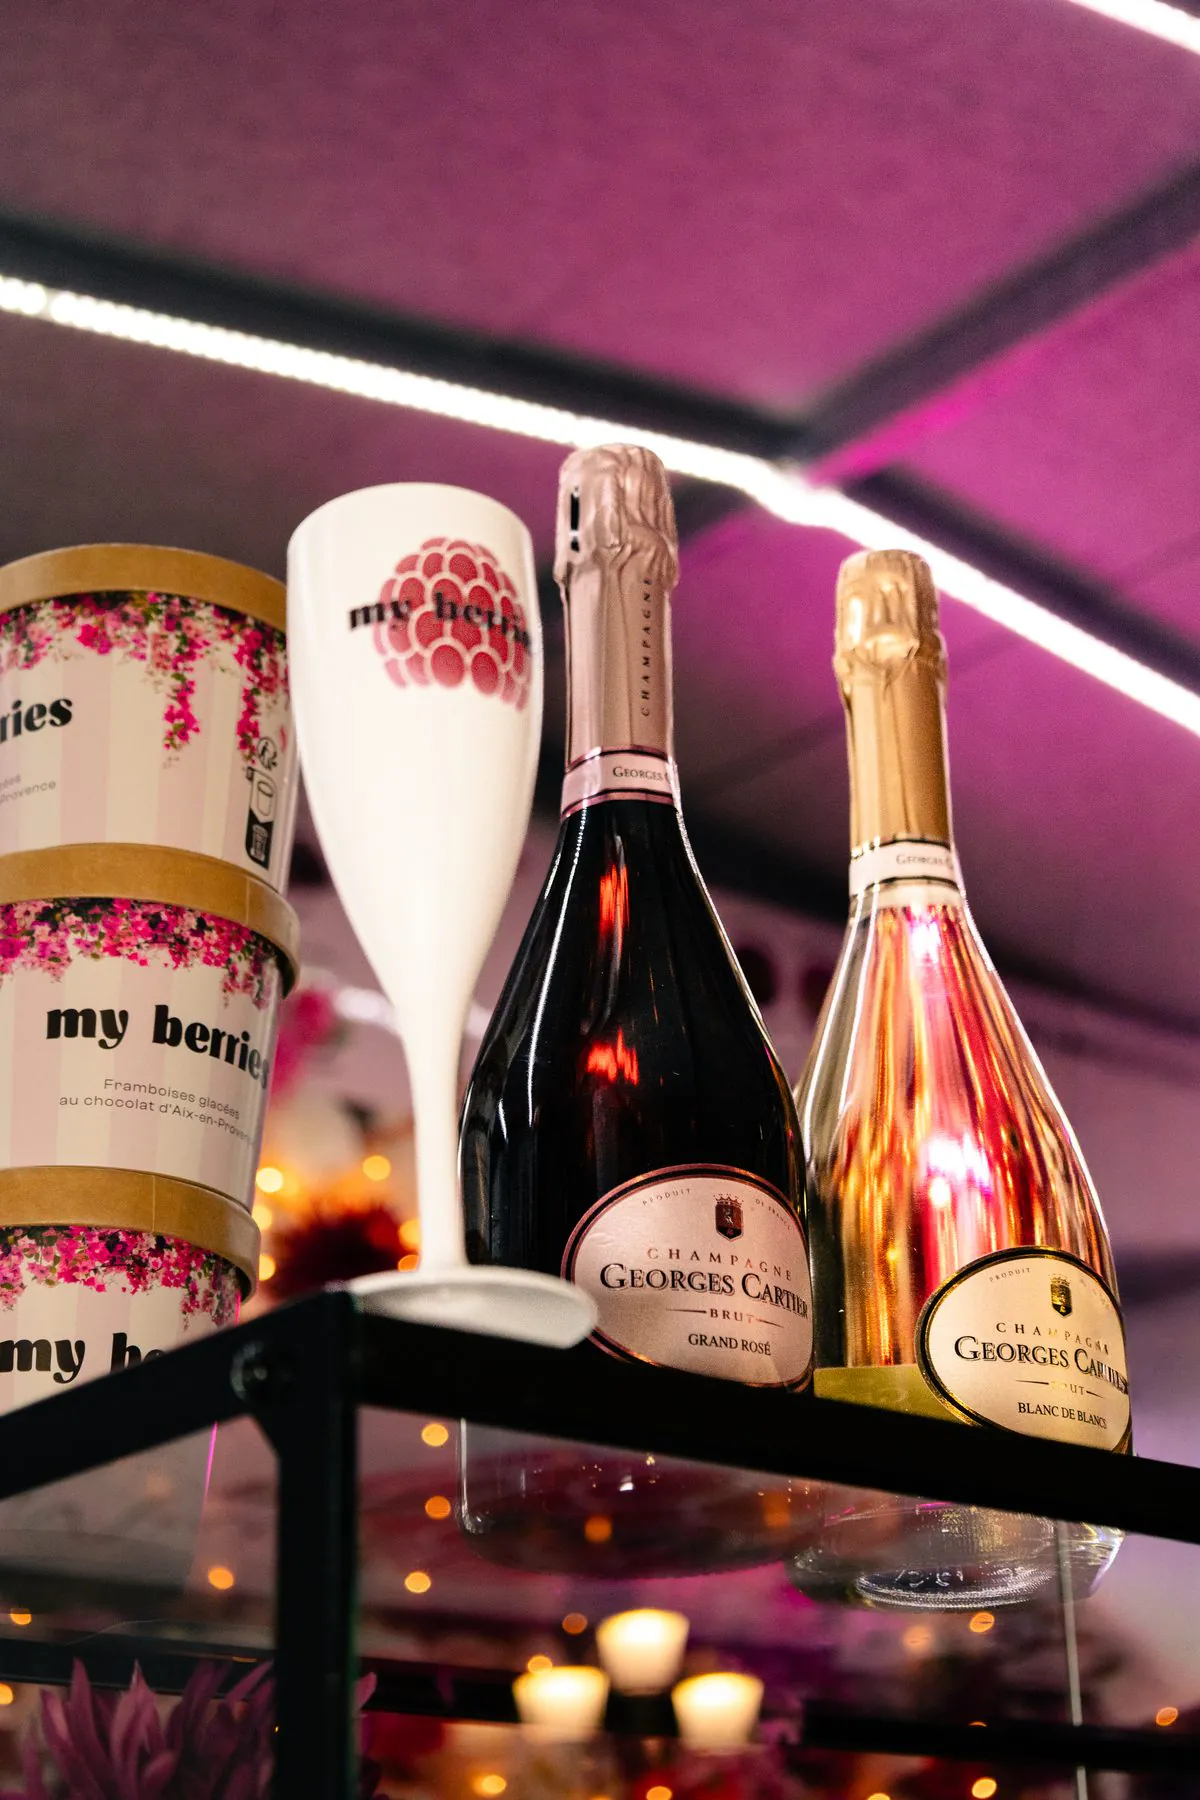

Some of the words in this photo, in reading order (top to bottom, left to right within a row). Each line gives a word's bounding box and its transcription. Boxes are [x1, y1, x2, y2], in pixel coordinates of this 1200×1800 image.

[641, 577, 652, 716] CHAMPAGNE
[46, 1007, 129, 1050] my
[59, 1096, 78, 1106] au
[84, 1095, 154, 1112] chocolat
[104, 1078, 196, 1102] Framboises
[199, 1096, 241, 1120] glacées
[642, 1187, 692, 1206] PRODUIT
[647, 1248, 792, 1281] CHAMPAGNE
[989, 1267, 1031, 1283] PRODUIT
[600, 1263, 735, 1296] GEORGES
[741, 1273, 809, 1319] CARTIER
[709, 1308, 755, 1324] BRUT
[0, 1339, 86, 1383] my
[688, 1333, 738, 1350] GRAND
[741, 1341, 772, 1356] ROSÉ
[954, 1335, 1069, 1368] GEORGES
[1018, 1402, 1059, 1418] BLANC
[1062, 1407, 1075, 1420] DE
[1077, 1411, 1107, 1430] BLANCS
